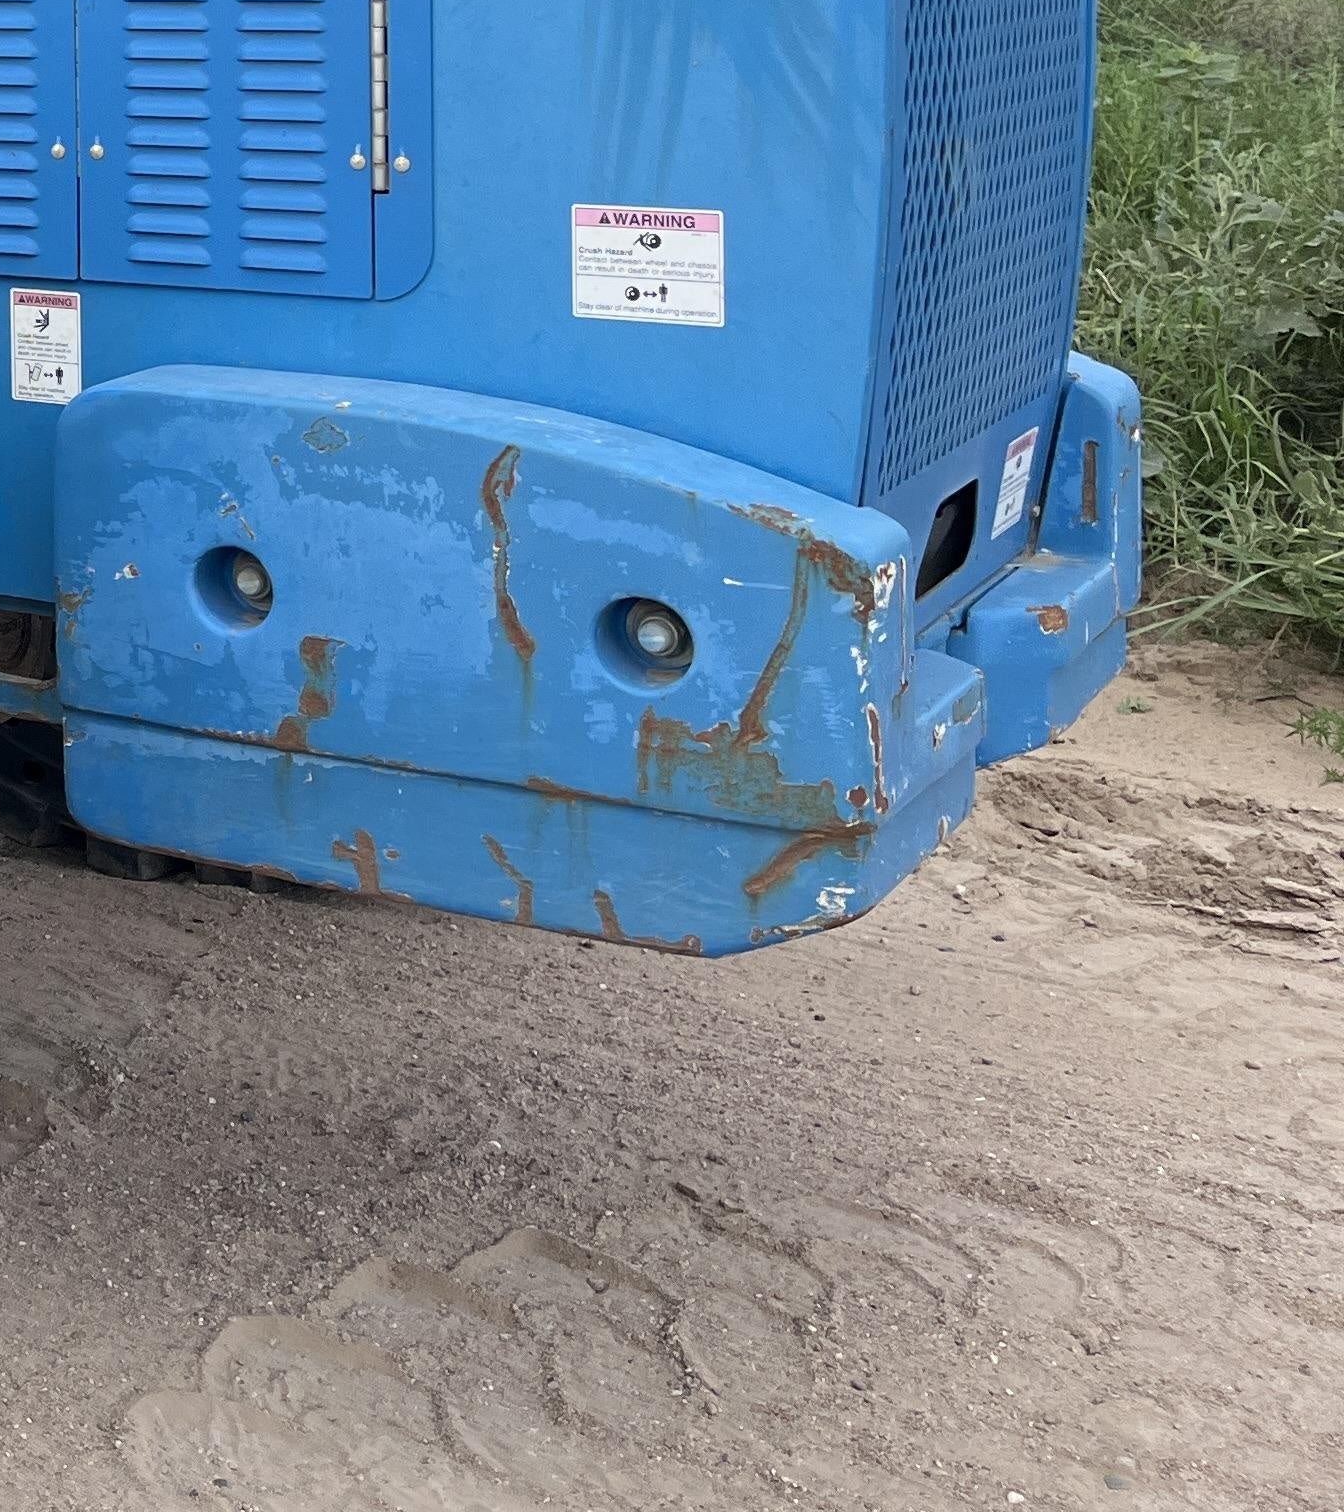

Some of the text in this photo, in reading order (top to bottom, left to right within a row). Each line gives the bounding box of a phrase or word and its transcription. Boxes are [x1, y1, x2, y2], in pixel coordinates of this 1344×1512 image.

[613, 212, 696, 229] WARNING
[578, 246, 633, 256] Crush Hazard
[578, 255, 607, 263] Contact
[610, 257, 641, 265] between
[26, 296, 72, 307] WARNING
[578, 301, 593, 311] Stay
[656, 308, 679, 317] during
